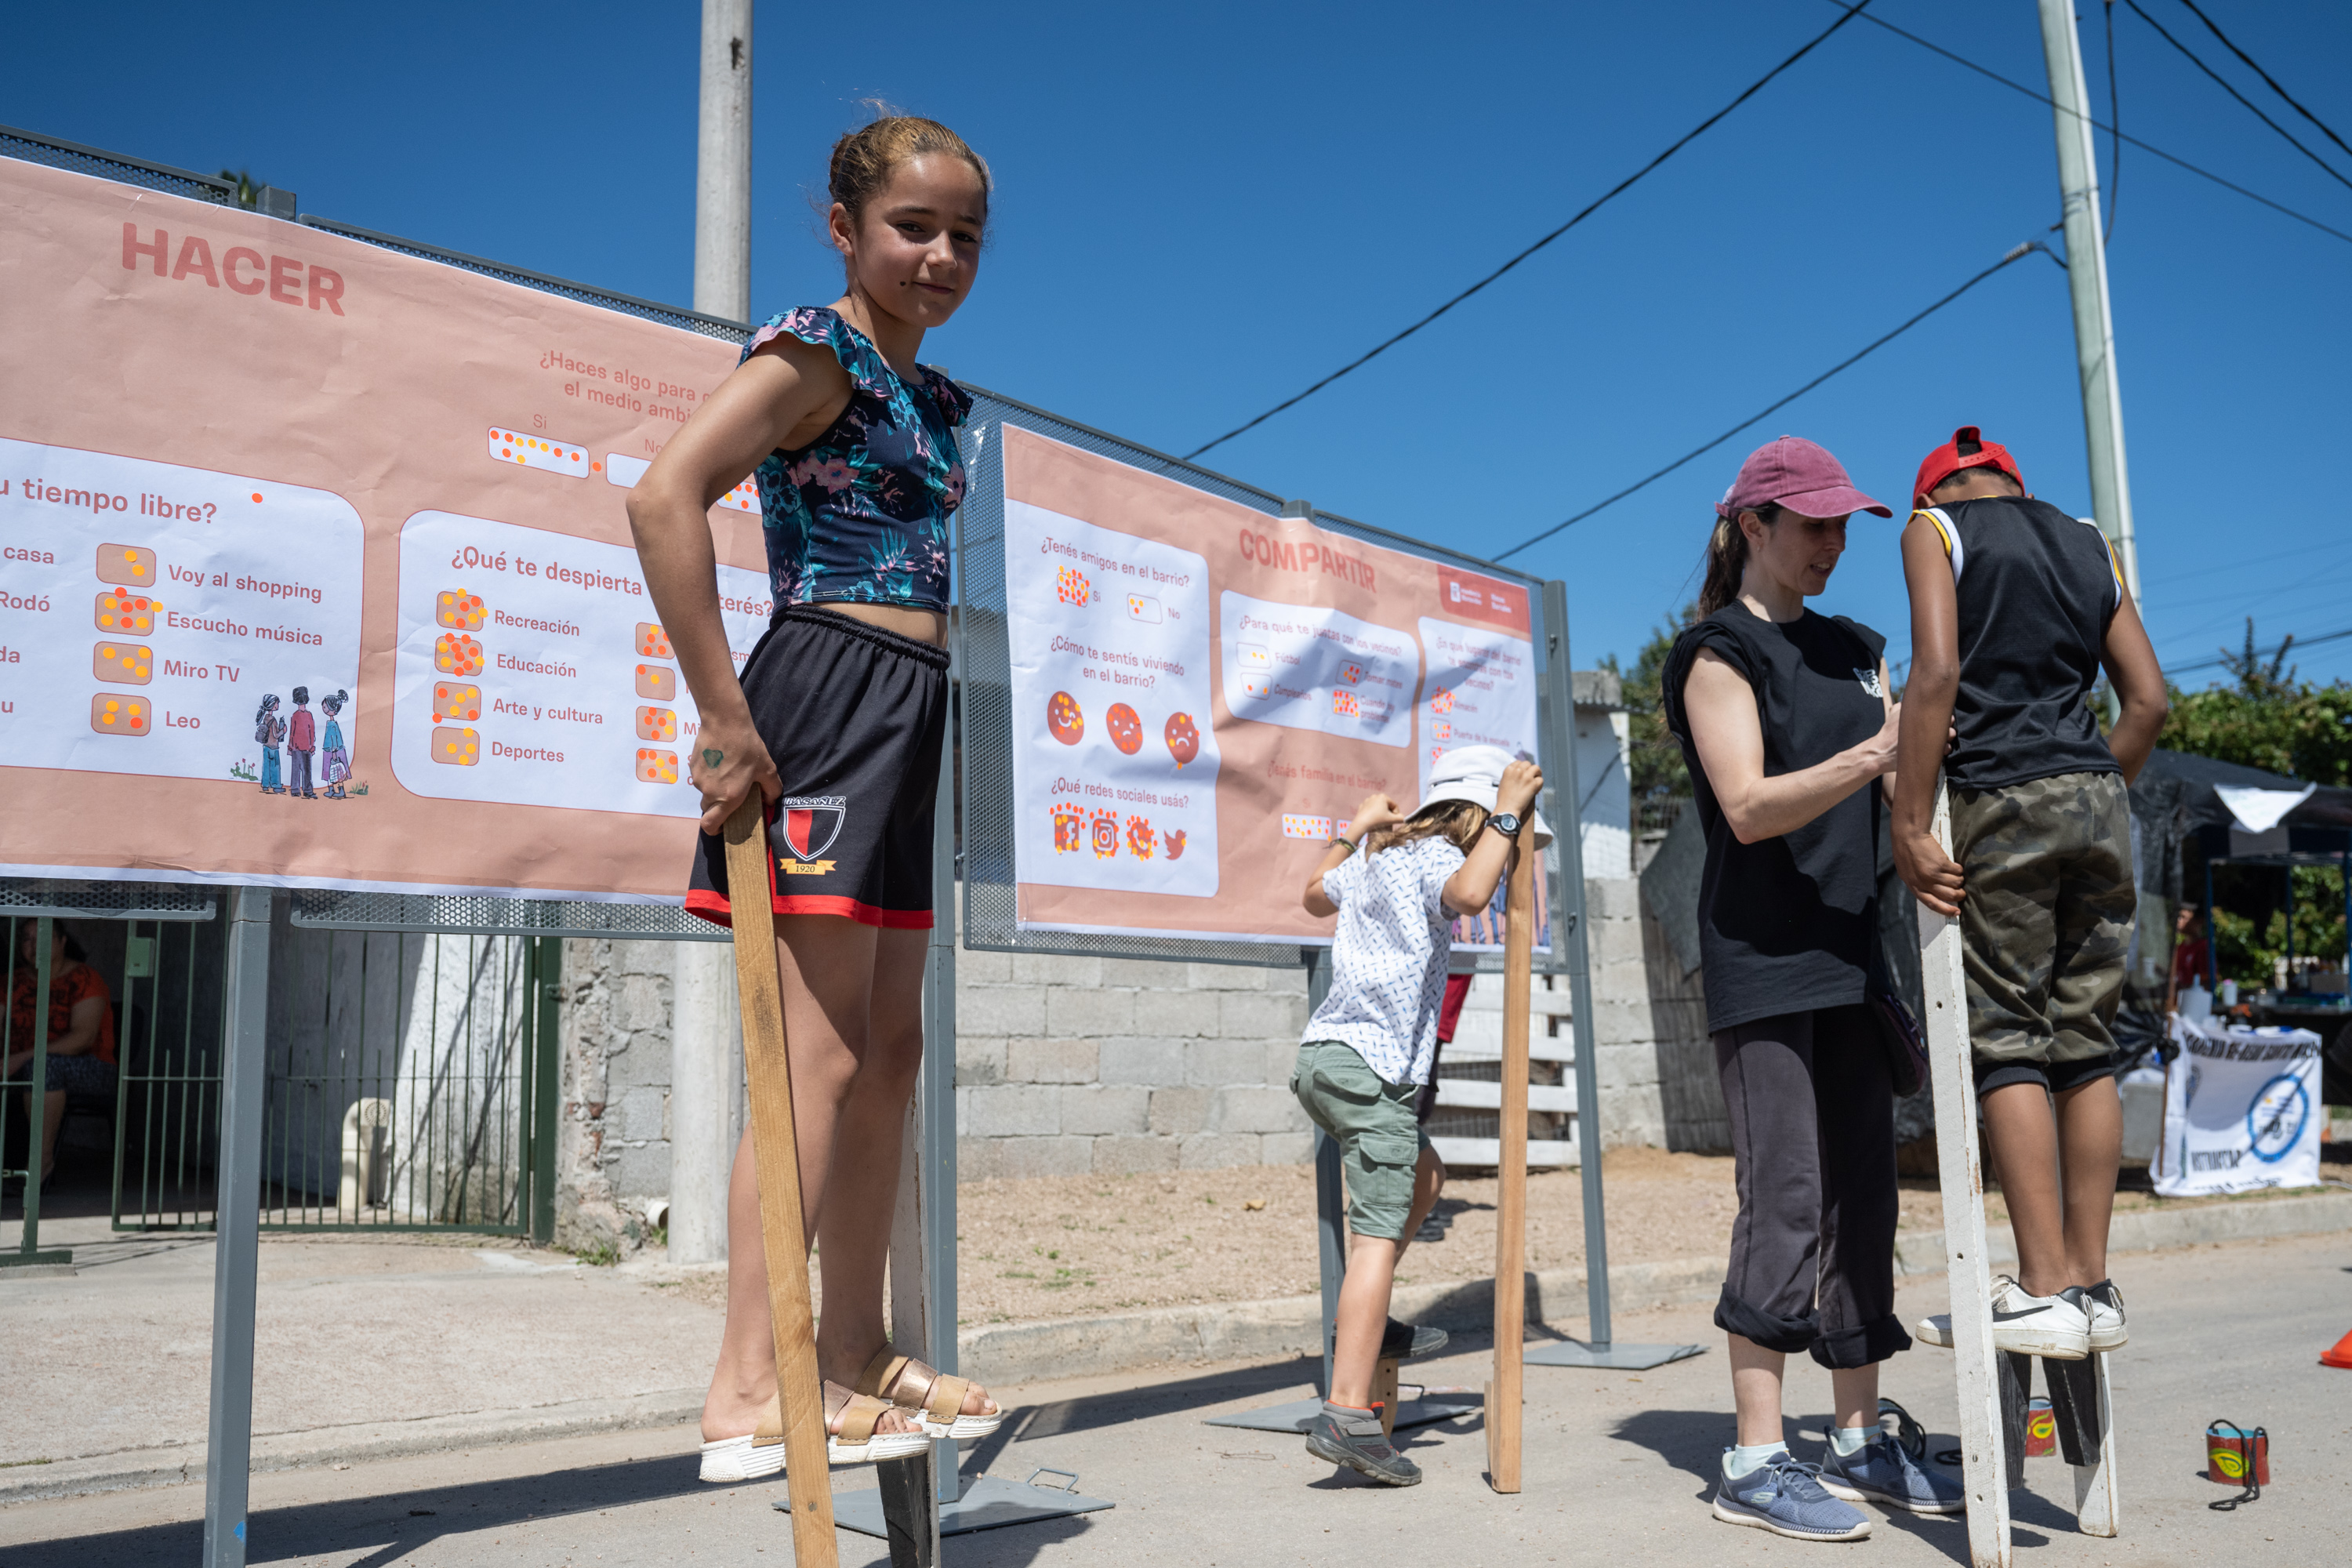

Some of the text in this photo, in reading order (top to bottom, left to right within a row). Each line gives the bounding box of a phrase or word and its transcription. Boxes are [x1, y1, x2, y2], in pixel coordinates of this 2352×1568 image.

[122, 222, 345, 317] HACER
[539, 350, 608, 380] ¿Haces
[615, 368, 652, 391] algo
[658, 381, 696, 402] para
[564, 383, 580, 398] el
[586, 388, 642, 414] medio
[533, 414, 546, 430] Si
[22, 478, 128, 514] tiempo
[141, 493, 217, 524] libre?
[4, 547, 54, 564] casa
[1041, 537, 1190, 588] ¿Tenés amigos en el barrio?
[1240, 528, 1377, 593] COMPARTIR
[452, 546, 642, 596] ¿Qué te despierta
[169, 565, 322, 604] Voy al shopping
[1093, 590, 1101, 603] Si
[0, 591, 49, 612] Rodó
[1168, 608, 1181, 619] No
[167, 612, 323, 646] Escucho música
[494, 610, 580, 637] Recreación
[1240, 615, 1269, 630] ¿Para
[1272, 622, 1294, 634] qué
[1297, 624, 1309, 634] te
[1342, 633, 1355, 645] con
[1356, 637, 1368, 649] los
[1370, 641, 1403, 657] vecinos?
[1051, 636, 1185, 676] ¿Cómo te sentís viviendo
[1275, 652, 1301, 665] Fútbol
[1450, 641, 1464, 652] qué
[1503, 652, 1521, 666] barrio
[164, 660, 240, 682] Miro TV
[497, 654, 577, 678] Educación
[1083, 666, 1155, 688] en el barrio?
[1490, 667, 1501, 677] con
[1274, 684, 1312, 701] Cumpleaños
[1465, 677, 1494, 691] vecinos?
[493, 698, 603, 724] Arte y cultura
[1360, 695, 1386, 709] Cuando
[165, 711, 201, 729] Leo
[1454, 728, 1472, 739] Puerta
[492, 741, 565, 763] Deportes
[1268, 760, 1387, 791] ¿Tenés familia en el barrio?
[1051, 777, 1189, 808] ¿Qué redes sociales usás?
